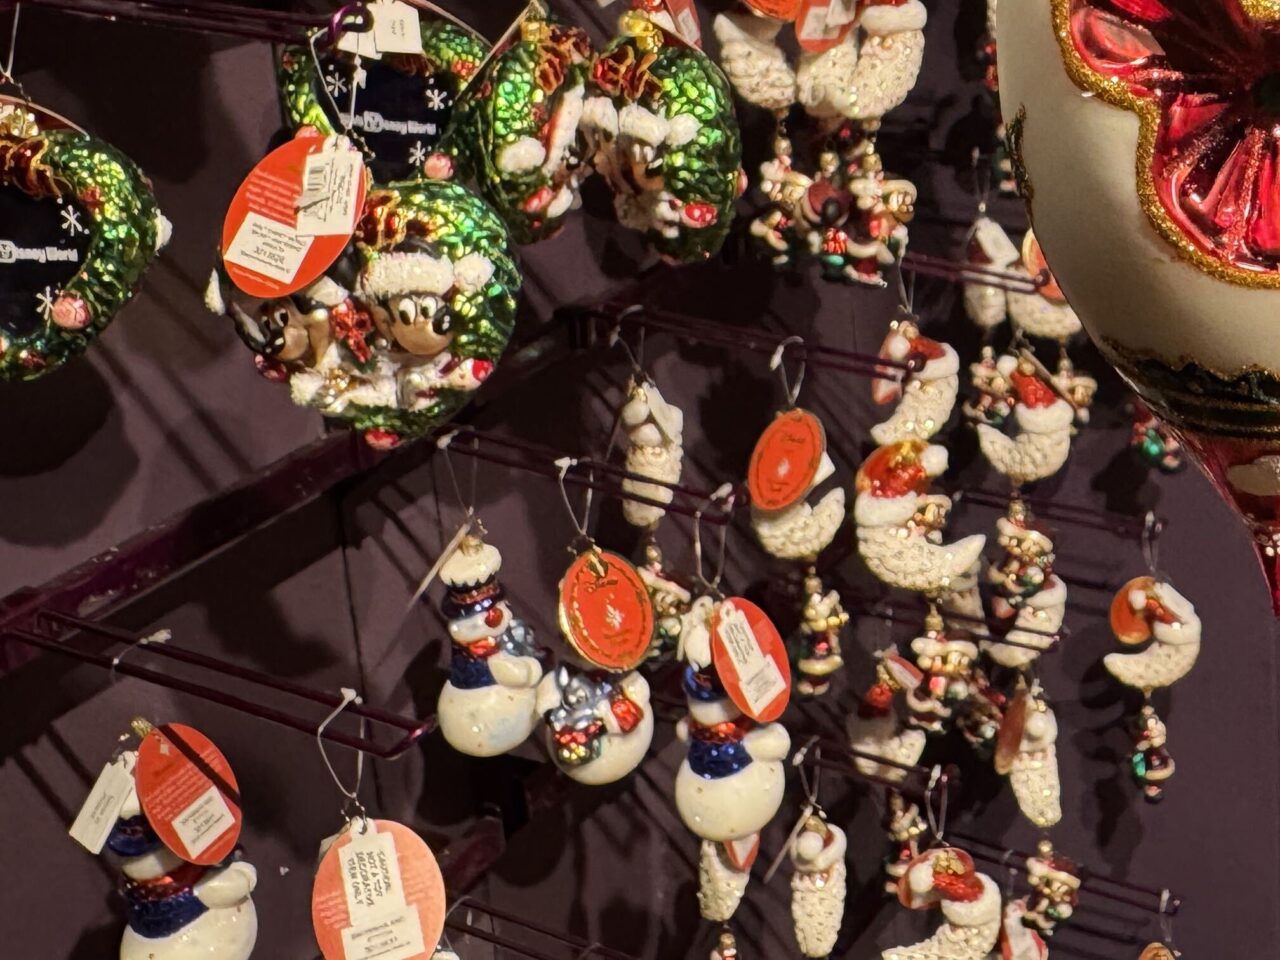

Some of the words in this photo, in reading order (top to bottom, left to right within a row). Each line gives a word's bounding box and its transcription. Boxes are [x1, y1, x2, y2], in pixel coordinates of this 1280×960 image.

[364, 111, 407, 135] Disney
[408, 120, 436, 135] World
[46, 246, 78, 262] World
